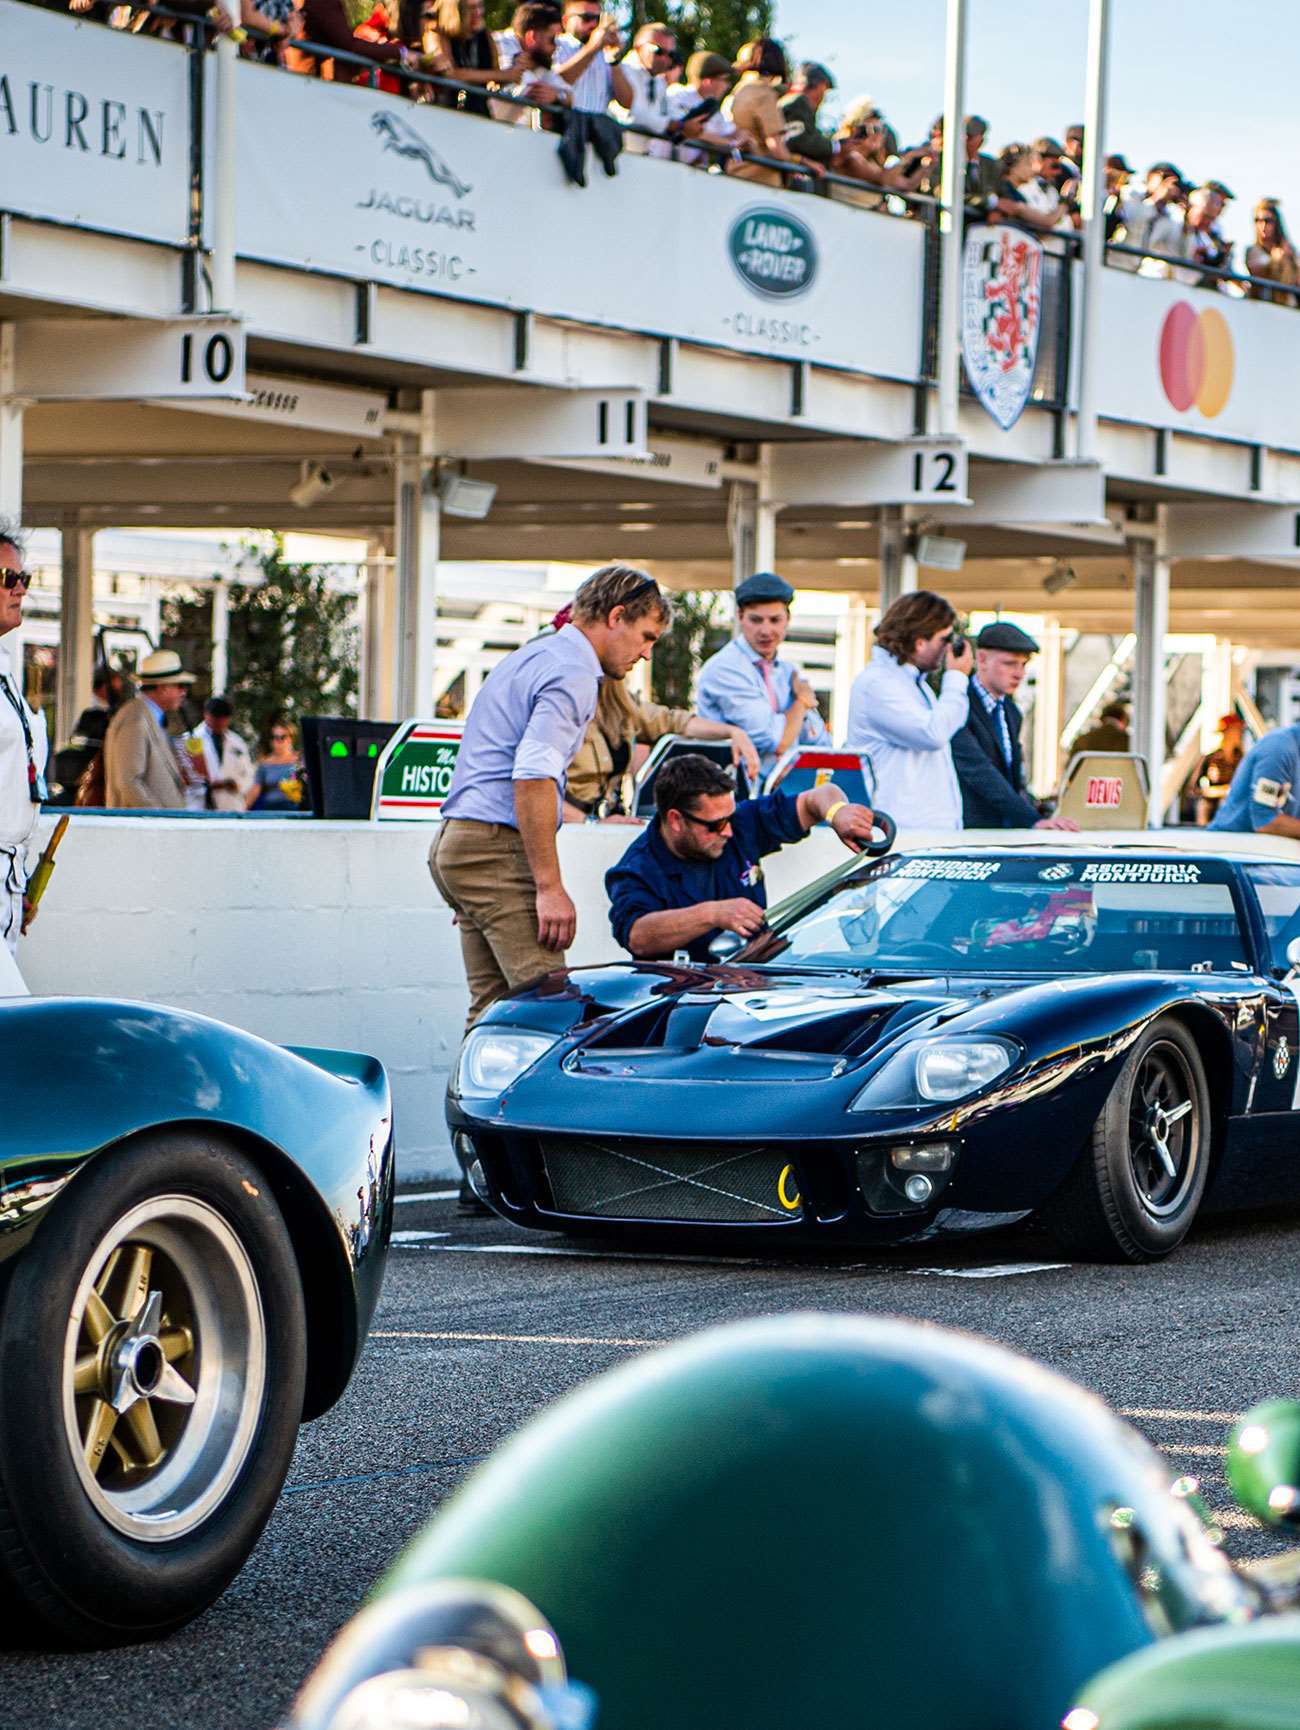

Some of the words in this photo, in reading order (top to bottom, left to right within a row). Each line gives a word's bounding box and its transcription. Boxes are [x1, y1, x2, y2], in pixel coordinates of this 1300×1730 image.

[354, 188, 476, 232] JAGUAR
[748, 248, 807, 283] ROVER
[180, 333, 234, 383] 10
[598, 400, 635, 445] 11
[912, 452, 956, 492] 12
[1079, 872, 1199, 883] MONTJUICH
[1084, 863, 1201, 875] ESCUDERIA
